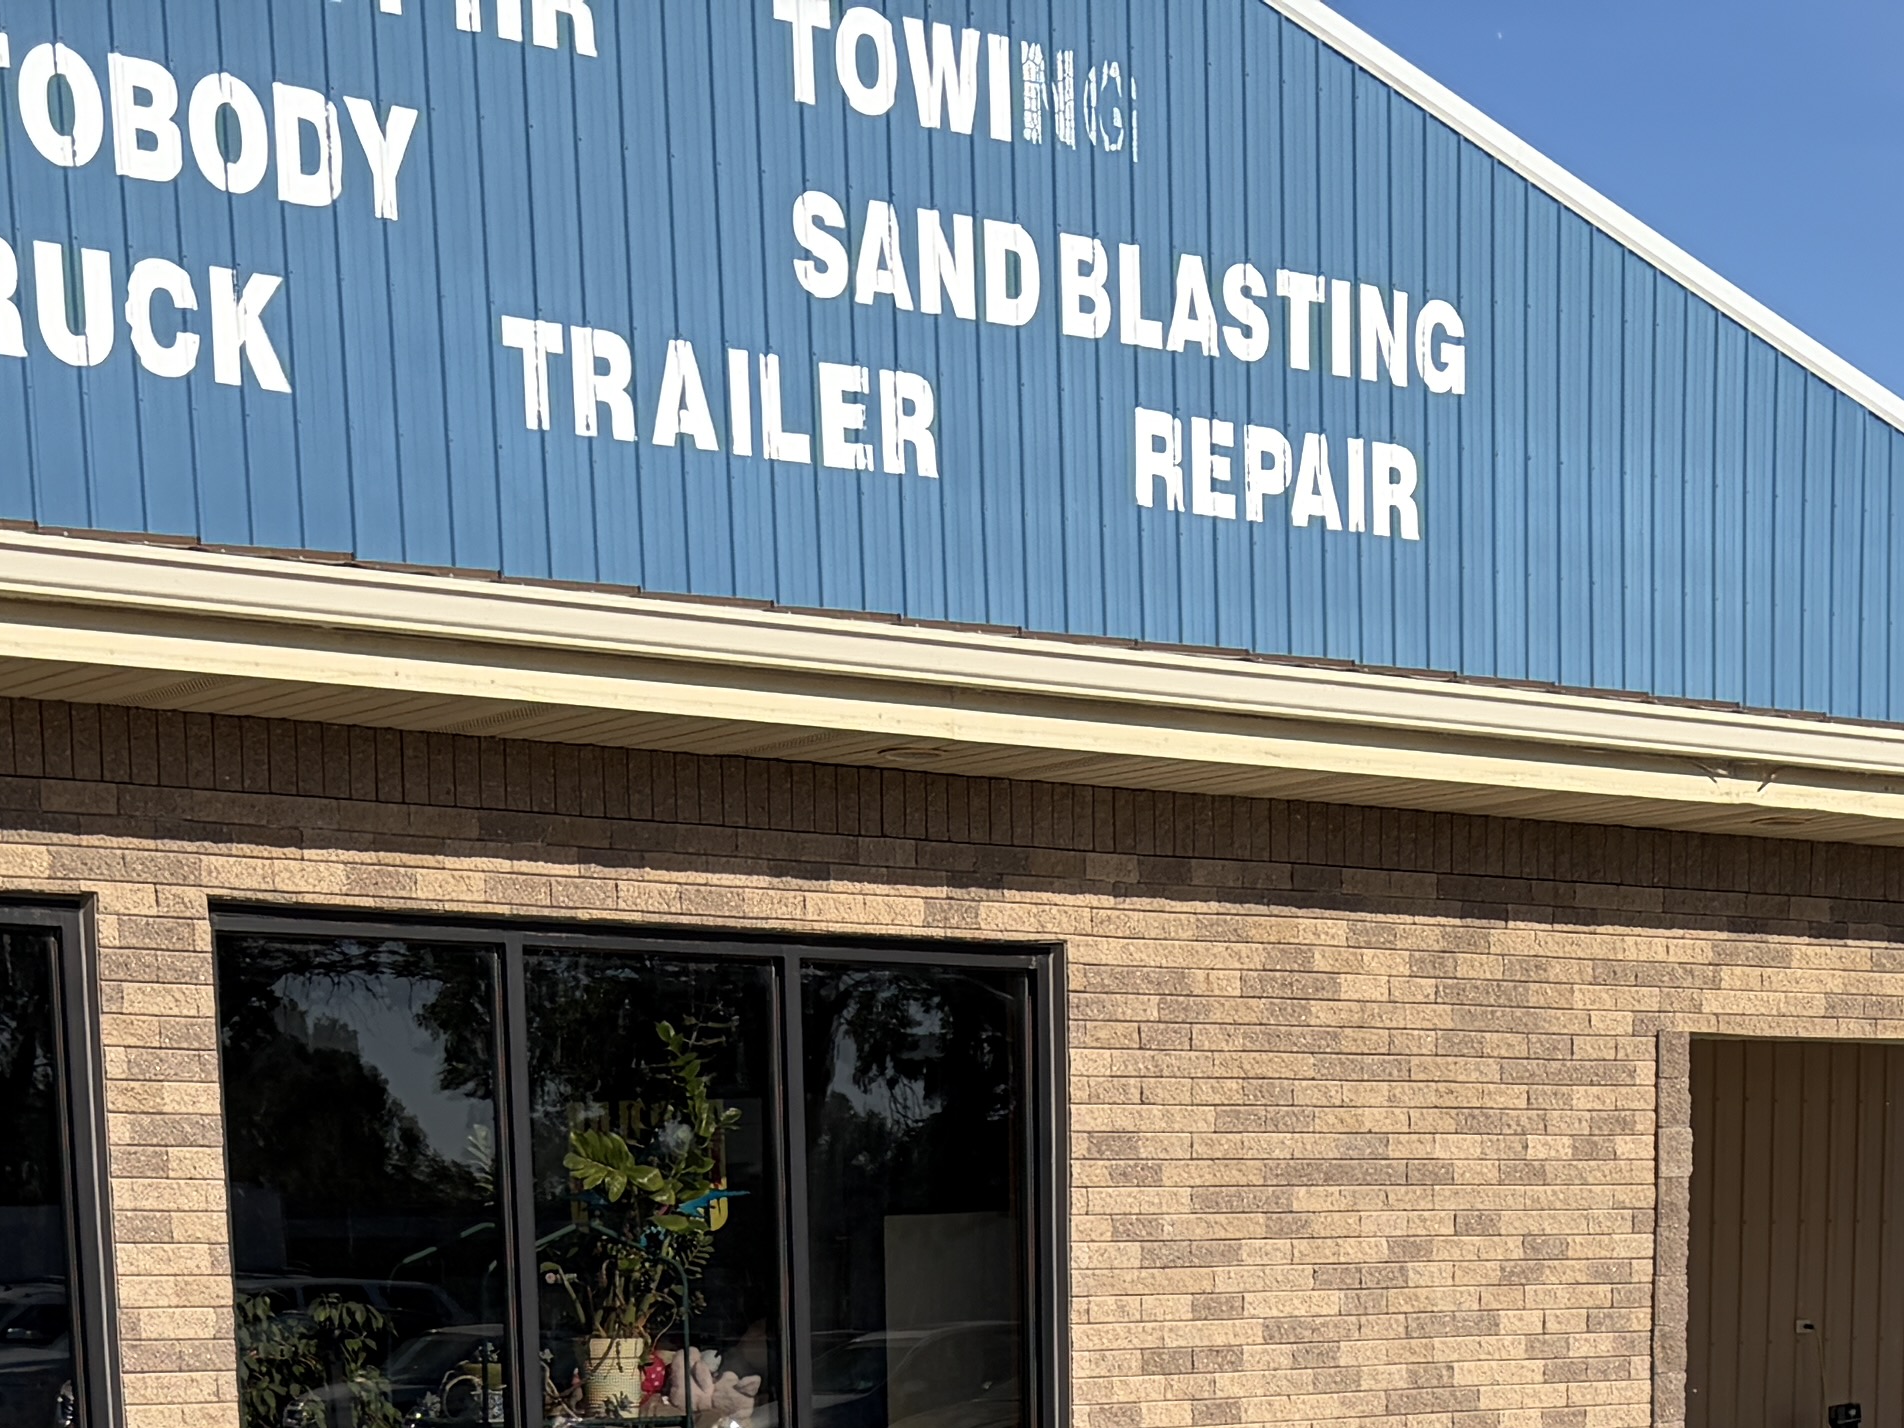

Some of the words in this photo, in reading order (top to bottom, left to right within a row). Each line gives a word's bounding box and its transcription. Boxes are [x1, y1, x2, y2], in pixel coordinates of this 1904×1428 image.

[791, 190, 1040, 326] SAND
[1059, 232, 1467, 395] BLASTING
[501, 314, 939, 478] TRAILER
[1134, 406, 1420, 541] REPAIR
